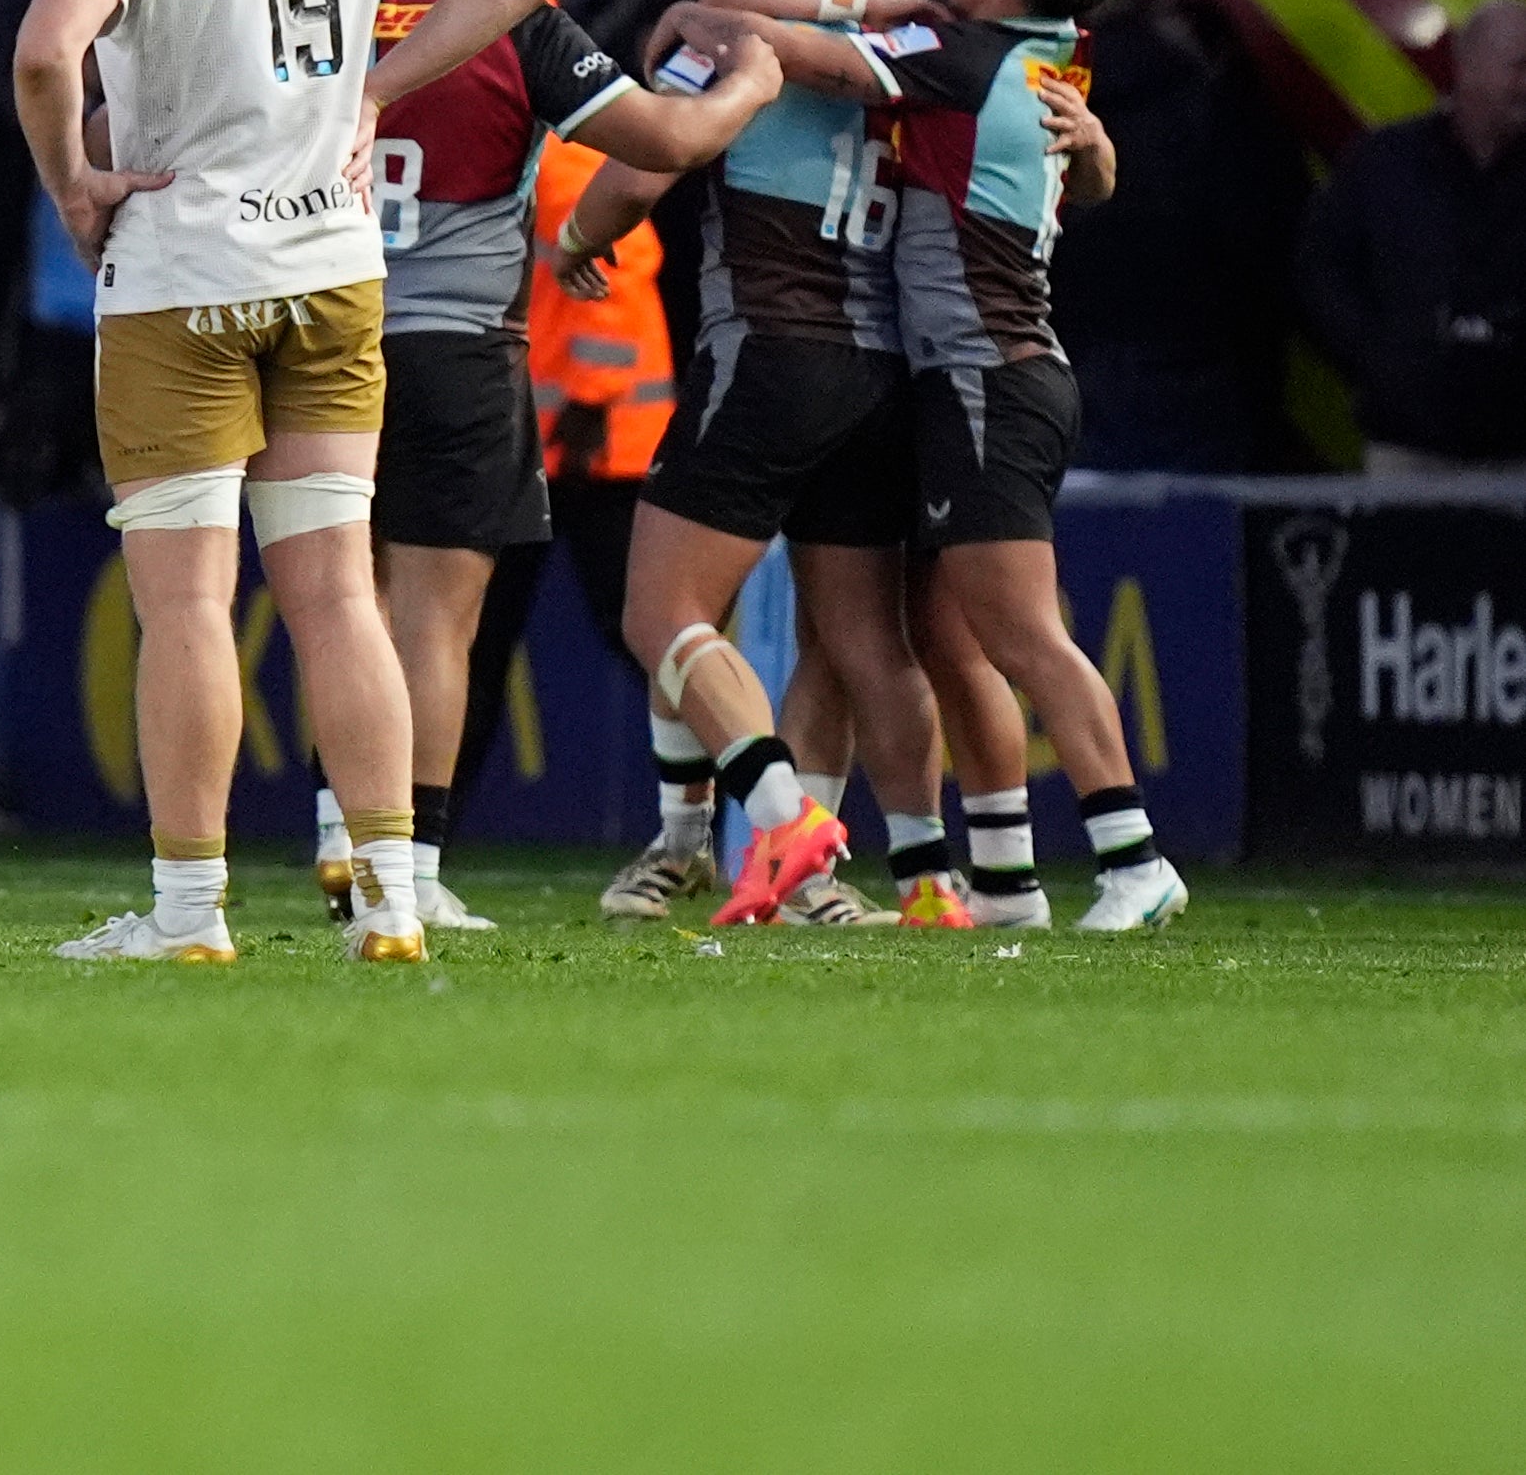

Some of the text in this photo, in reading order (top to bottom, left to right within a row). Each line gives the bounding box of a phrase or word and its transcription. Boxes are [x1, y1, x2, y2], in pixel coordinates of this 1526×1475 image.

[239, 181, 354, 223] Stone
[819, 131, 899, 254] 16
[1357, 589, 1526, 725] Harle
[1359, 771, 1522, 836] WOMEN
